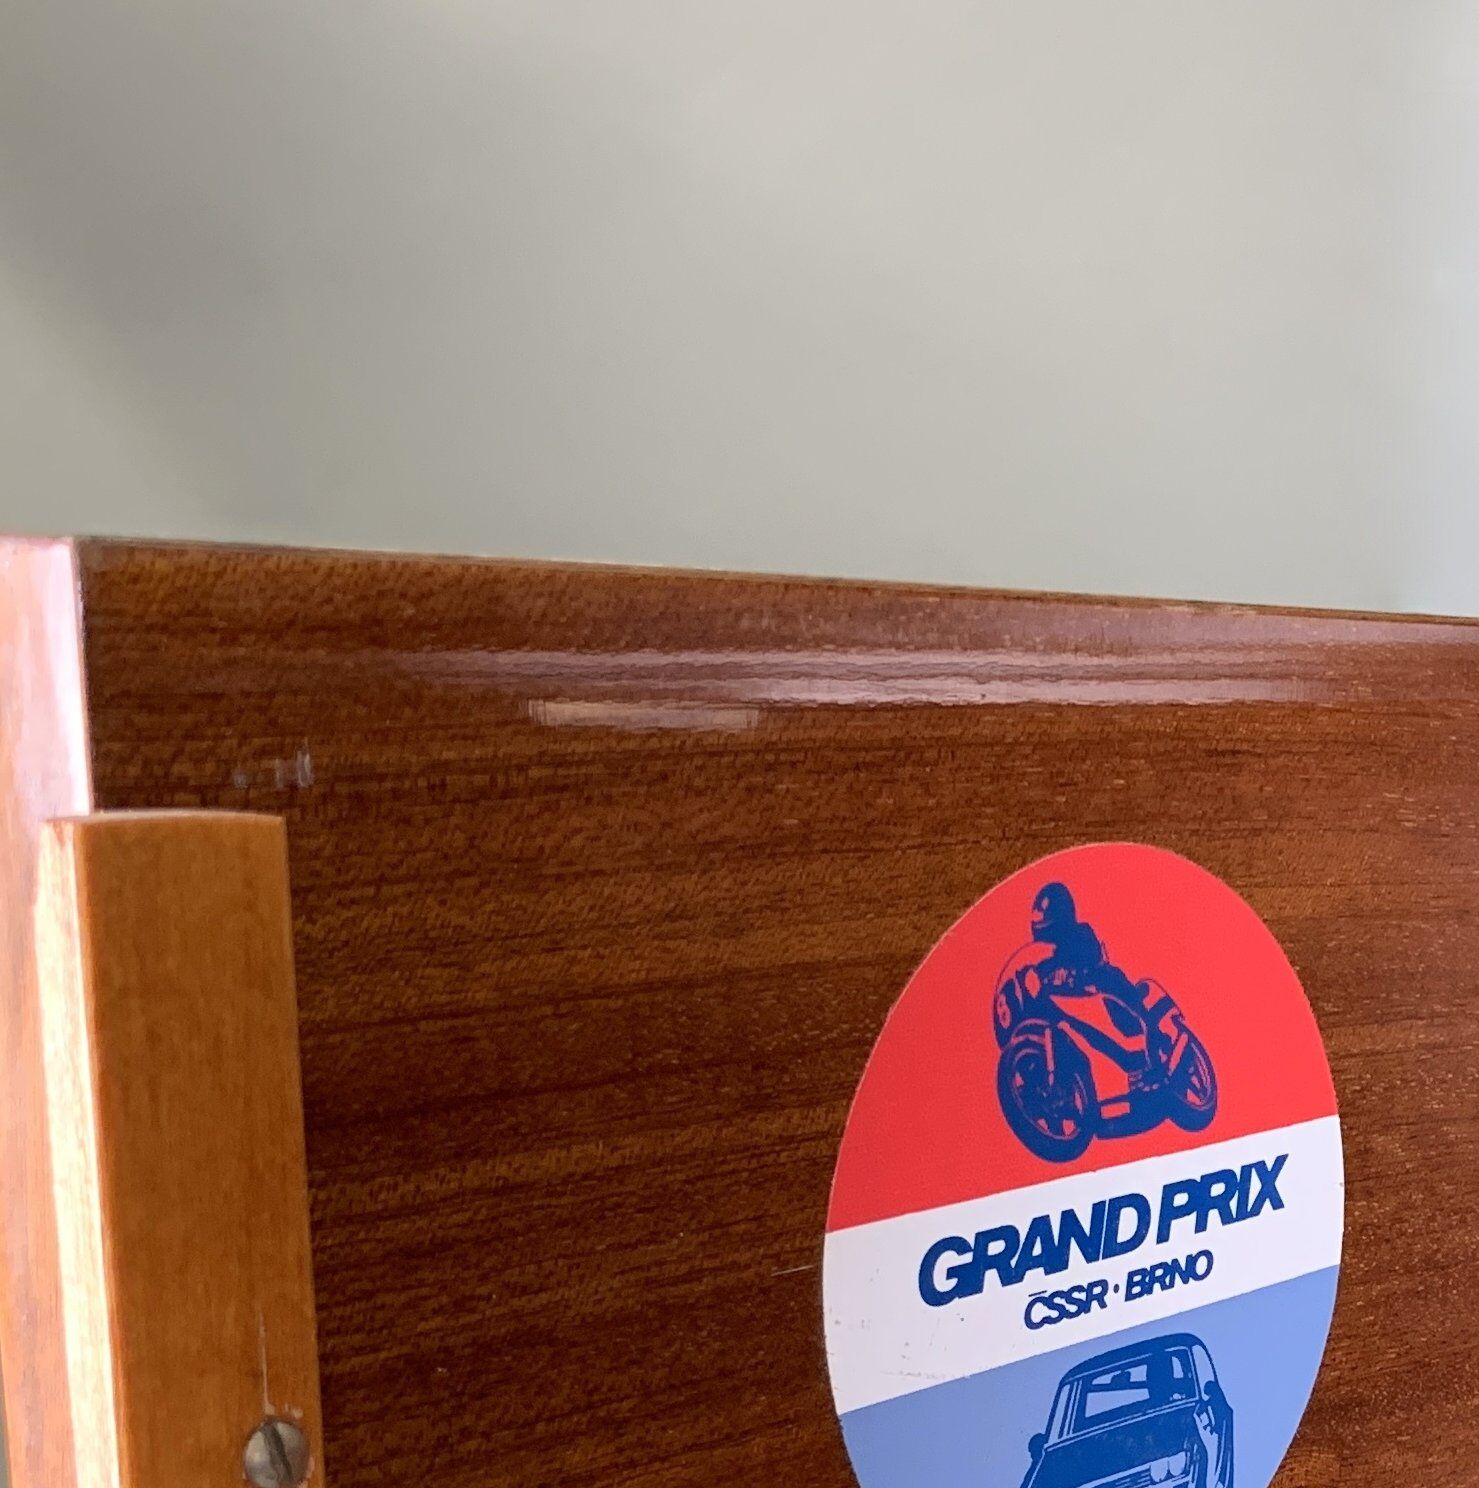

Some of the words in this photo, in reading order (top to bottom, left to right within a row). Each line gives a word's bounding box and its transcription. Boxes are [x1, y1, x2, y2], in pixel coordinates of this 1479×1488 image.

[918, 1192, 1152, 1308] GRAND
[1156, 1153, 1289, 1245] PRIX
[1124, 1249, 1214, 1302] BRNO
